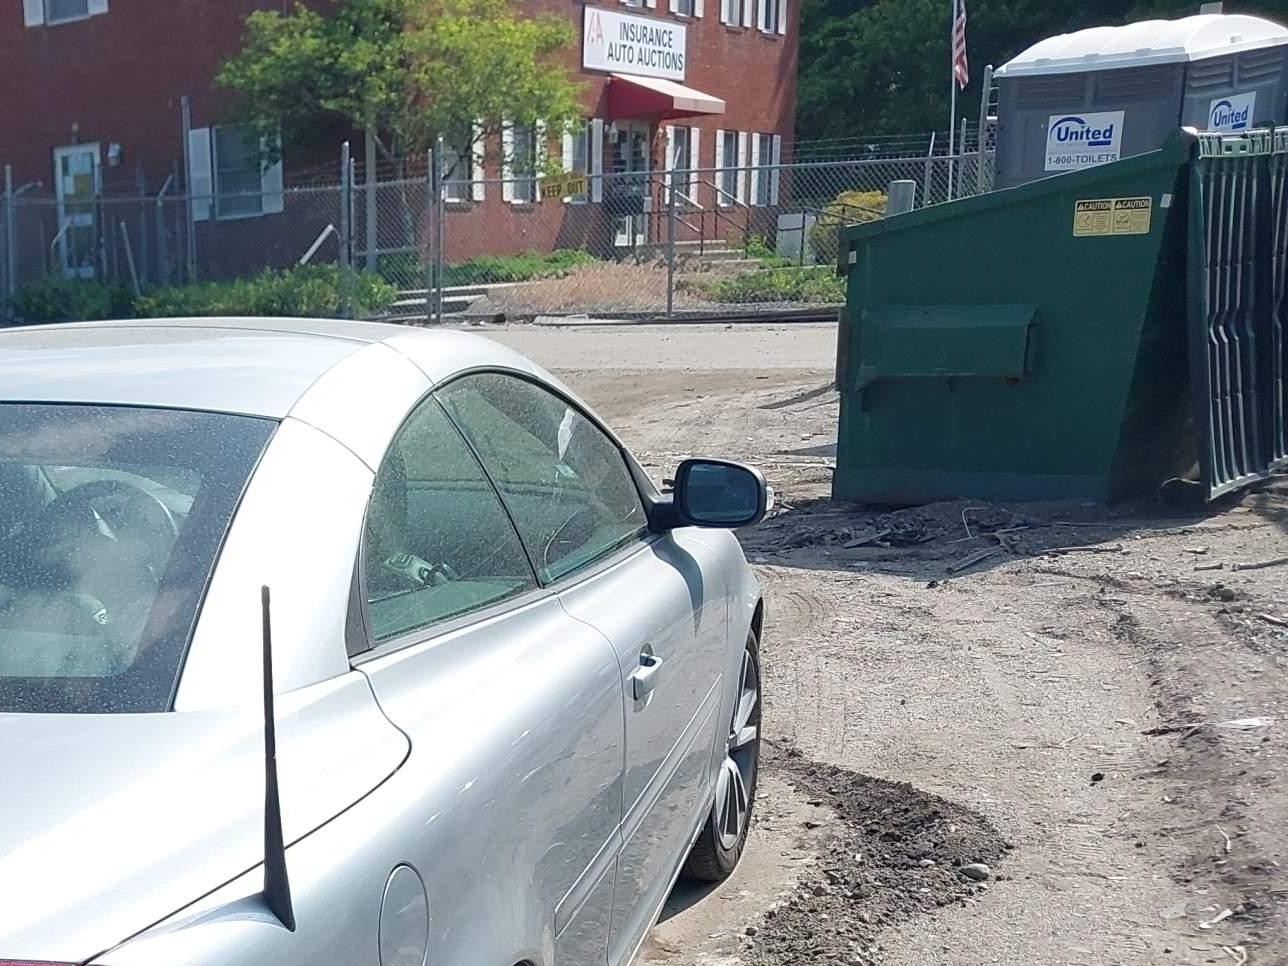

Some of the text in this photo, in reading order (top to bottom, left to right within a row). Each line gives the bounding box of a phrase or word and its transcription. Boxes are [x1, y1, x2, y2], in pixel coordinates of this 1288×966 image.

[619, 22, 673, 48] INSURANCE
[607, 41, 683, 71] AUTO AUCTIONS
[1214, 105, 1249, 127] United
[1057, 124, 1113, 142] United
[1048, 153, 1118, 165] 1-800-TOILETS
[1084, 202, 1111, 210] CAUTION
[1122, 200, 1149, 208] CAUTION
